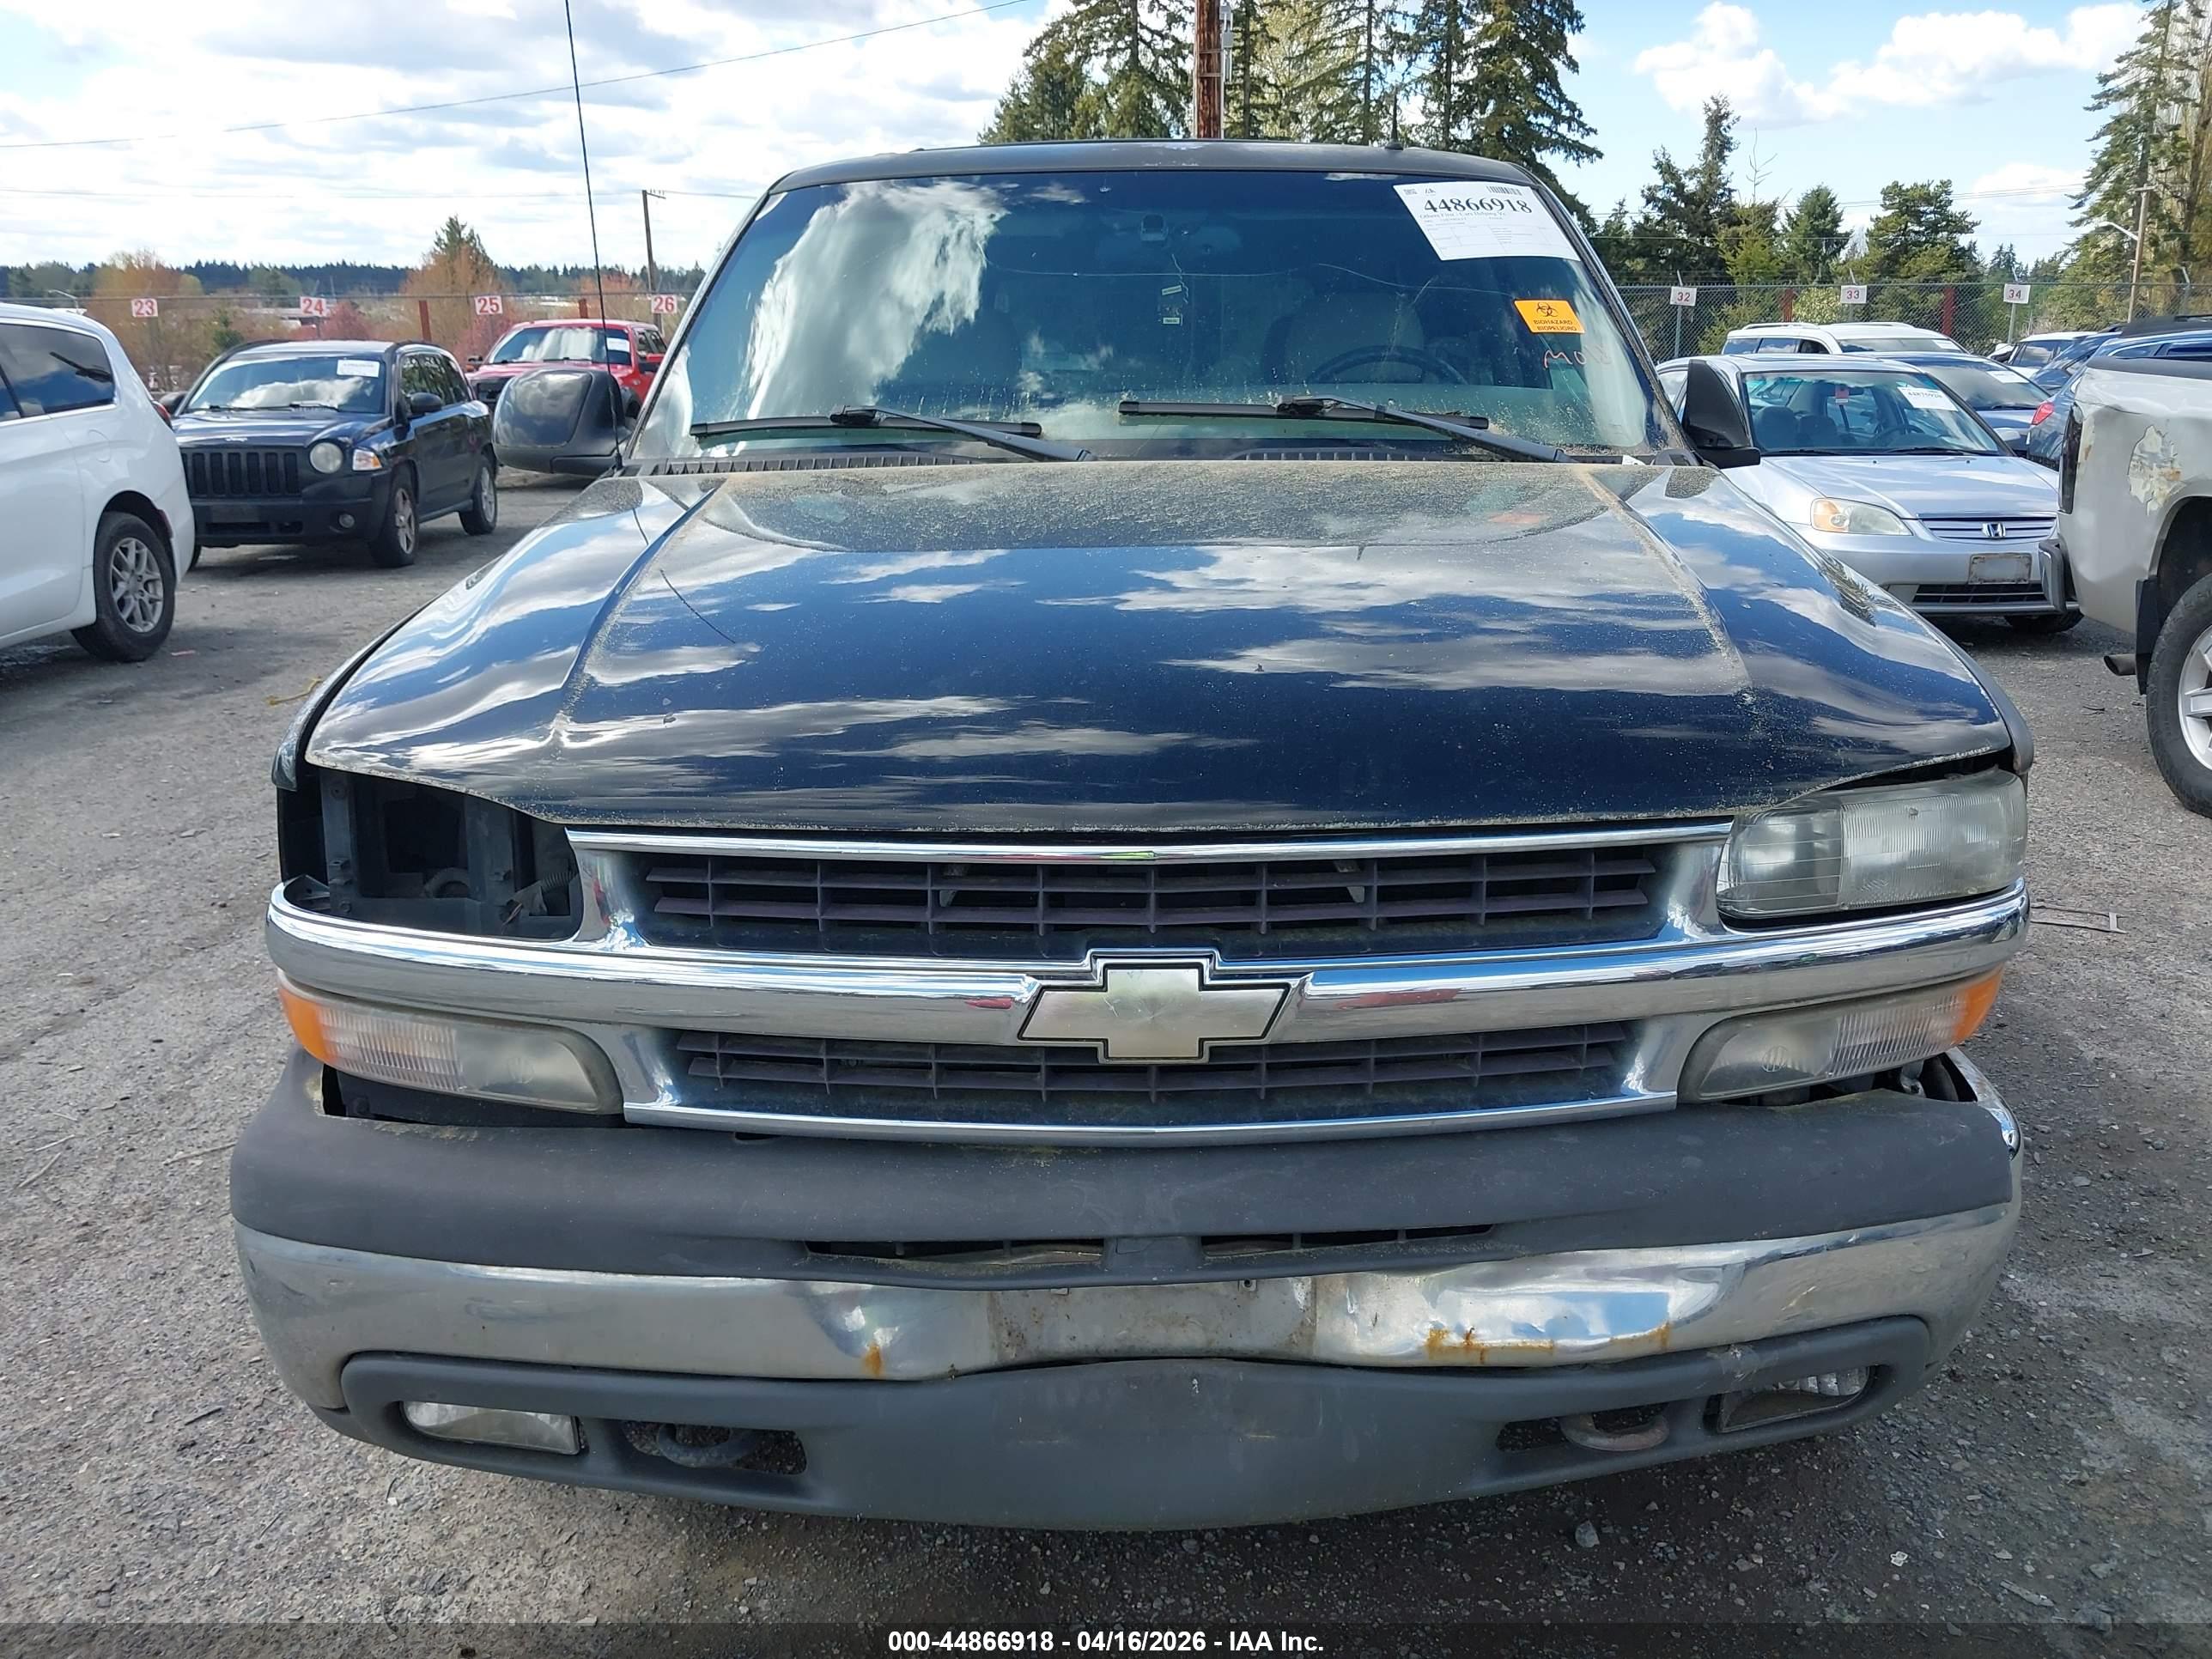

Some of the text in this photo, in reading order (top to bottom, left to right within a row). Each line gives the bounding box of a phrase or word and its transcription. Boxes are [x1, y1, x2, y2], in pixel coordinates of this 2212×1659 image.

[1424, 197, 1532, 214] 44866918
[1677, 292, 1691, 302] 32
[1846, 289, 1860, 299] 33
[2008, 289, 2021, 299] 34
[137, 301, 155, 316] 23
[302, 298, 324, 314] 24
[477, 297, 500, 314] 25
[653, 296, 674, 312] 26
